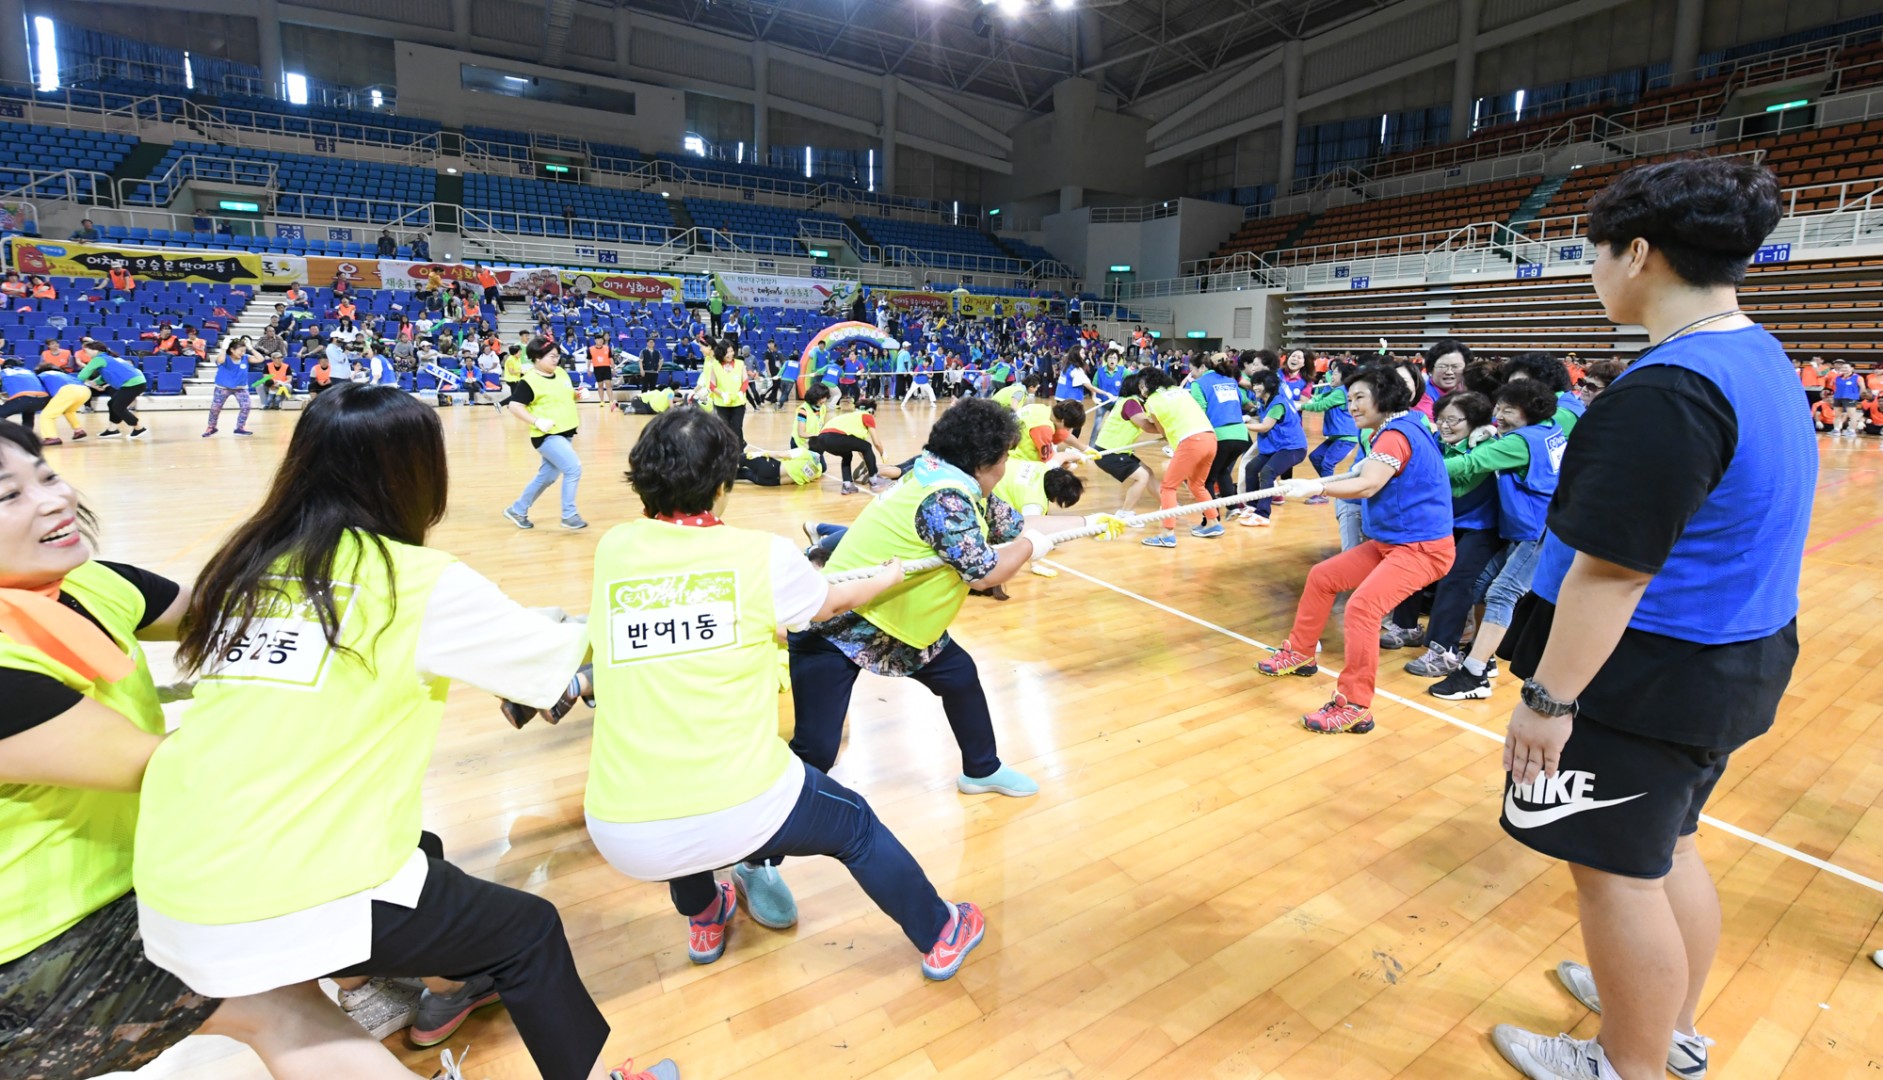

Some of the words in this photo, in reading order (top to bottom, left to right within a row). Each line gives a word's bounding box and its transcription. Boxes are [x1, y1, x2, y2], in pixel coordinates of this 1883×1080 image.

[280, 229, 302, 240] 2-3
[331, 231, 349, 240] 3-3
[601, 254, 616, 263] 2-4
[1562, 250, 1582, 259] 3-10
[1758, 249, 1788, 262] 1-10
[135, 259, 176, 271] 우승은
[179, 261, 226, 273] 반여2동
[1519, 268, 1538, 278] 1-9
[603, 280, 623, 289] 이거
[626, 281, 660, 295] 실화냐?
[1353, 281, 1367, 289] 1-8
[628, 613, 718, 650] 반여1동
[212, 629, 299, 664] 송2동
